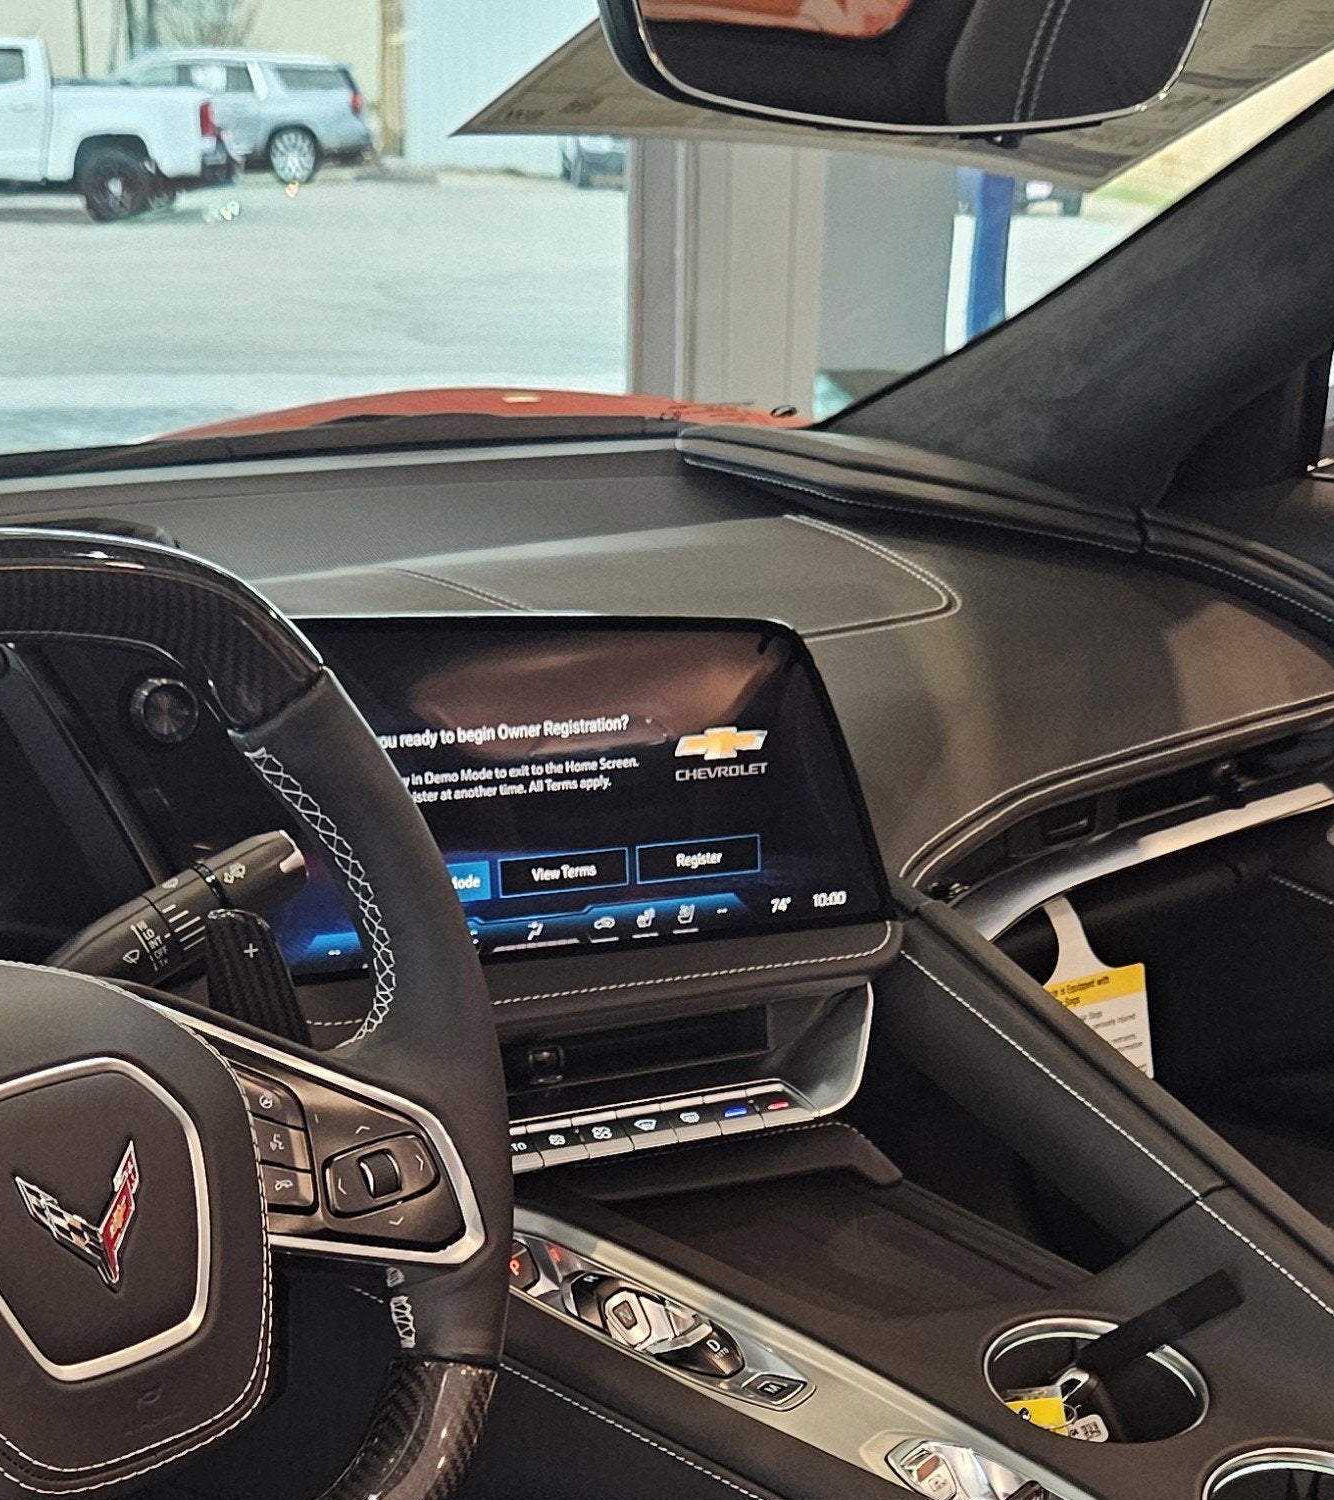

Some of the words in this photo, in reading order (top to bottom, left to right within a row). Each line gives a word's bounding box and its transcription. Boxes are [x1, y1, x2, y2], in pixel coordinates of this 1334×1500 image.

[376, 733, 399, 750] ou
[399, 729, 437, 749] ready
[439, 729, 455, 745] to
[457, 724, 496, 745] begin
[497, 721, 541, 740] Owner
[543, 714, 630, 738] Registration?
[411, 773, 423, 786] in
[424, 771, 459, 786] Demo
[460, 768, 493, 783] Mode
[494, 767, 507, 780] to
[508, 764, 530, 778] exit
[531, 763, 544, 776] to
[545, 760, 564, 775] the
[565, 758, 598, 774] Home
[599, 755, 640, 771] Screen.
[674, 760, 767, 783] CHEVROLET
[410, 788, 439, 804] ister
[440, 789, 452, 801] at
[453, 784, 497, 800] another
[499, 781, 527, 797] time.
[528, 779, 544, 794] All
[545, 777, 578, 793] Terms
[579, 775, 612, 791] apply.
[675, 850, 723, 872] Register
[530, 866, 561, 884] View
[561, 863, 597, 881] Terms
[812, 889, 847, 908] 10:00
[143, 928, 155, 940] LO
[706, 1339, 721, 1353] D
